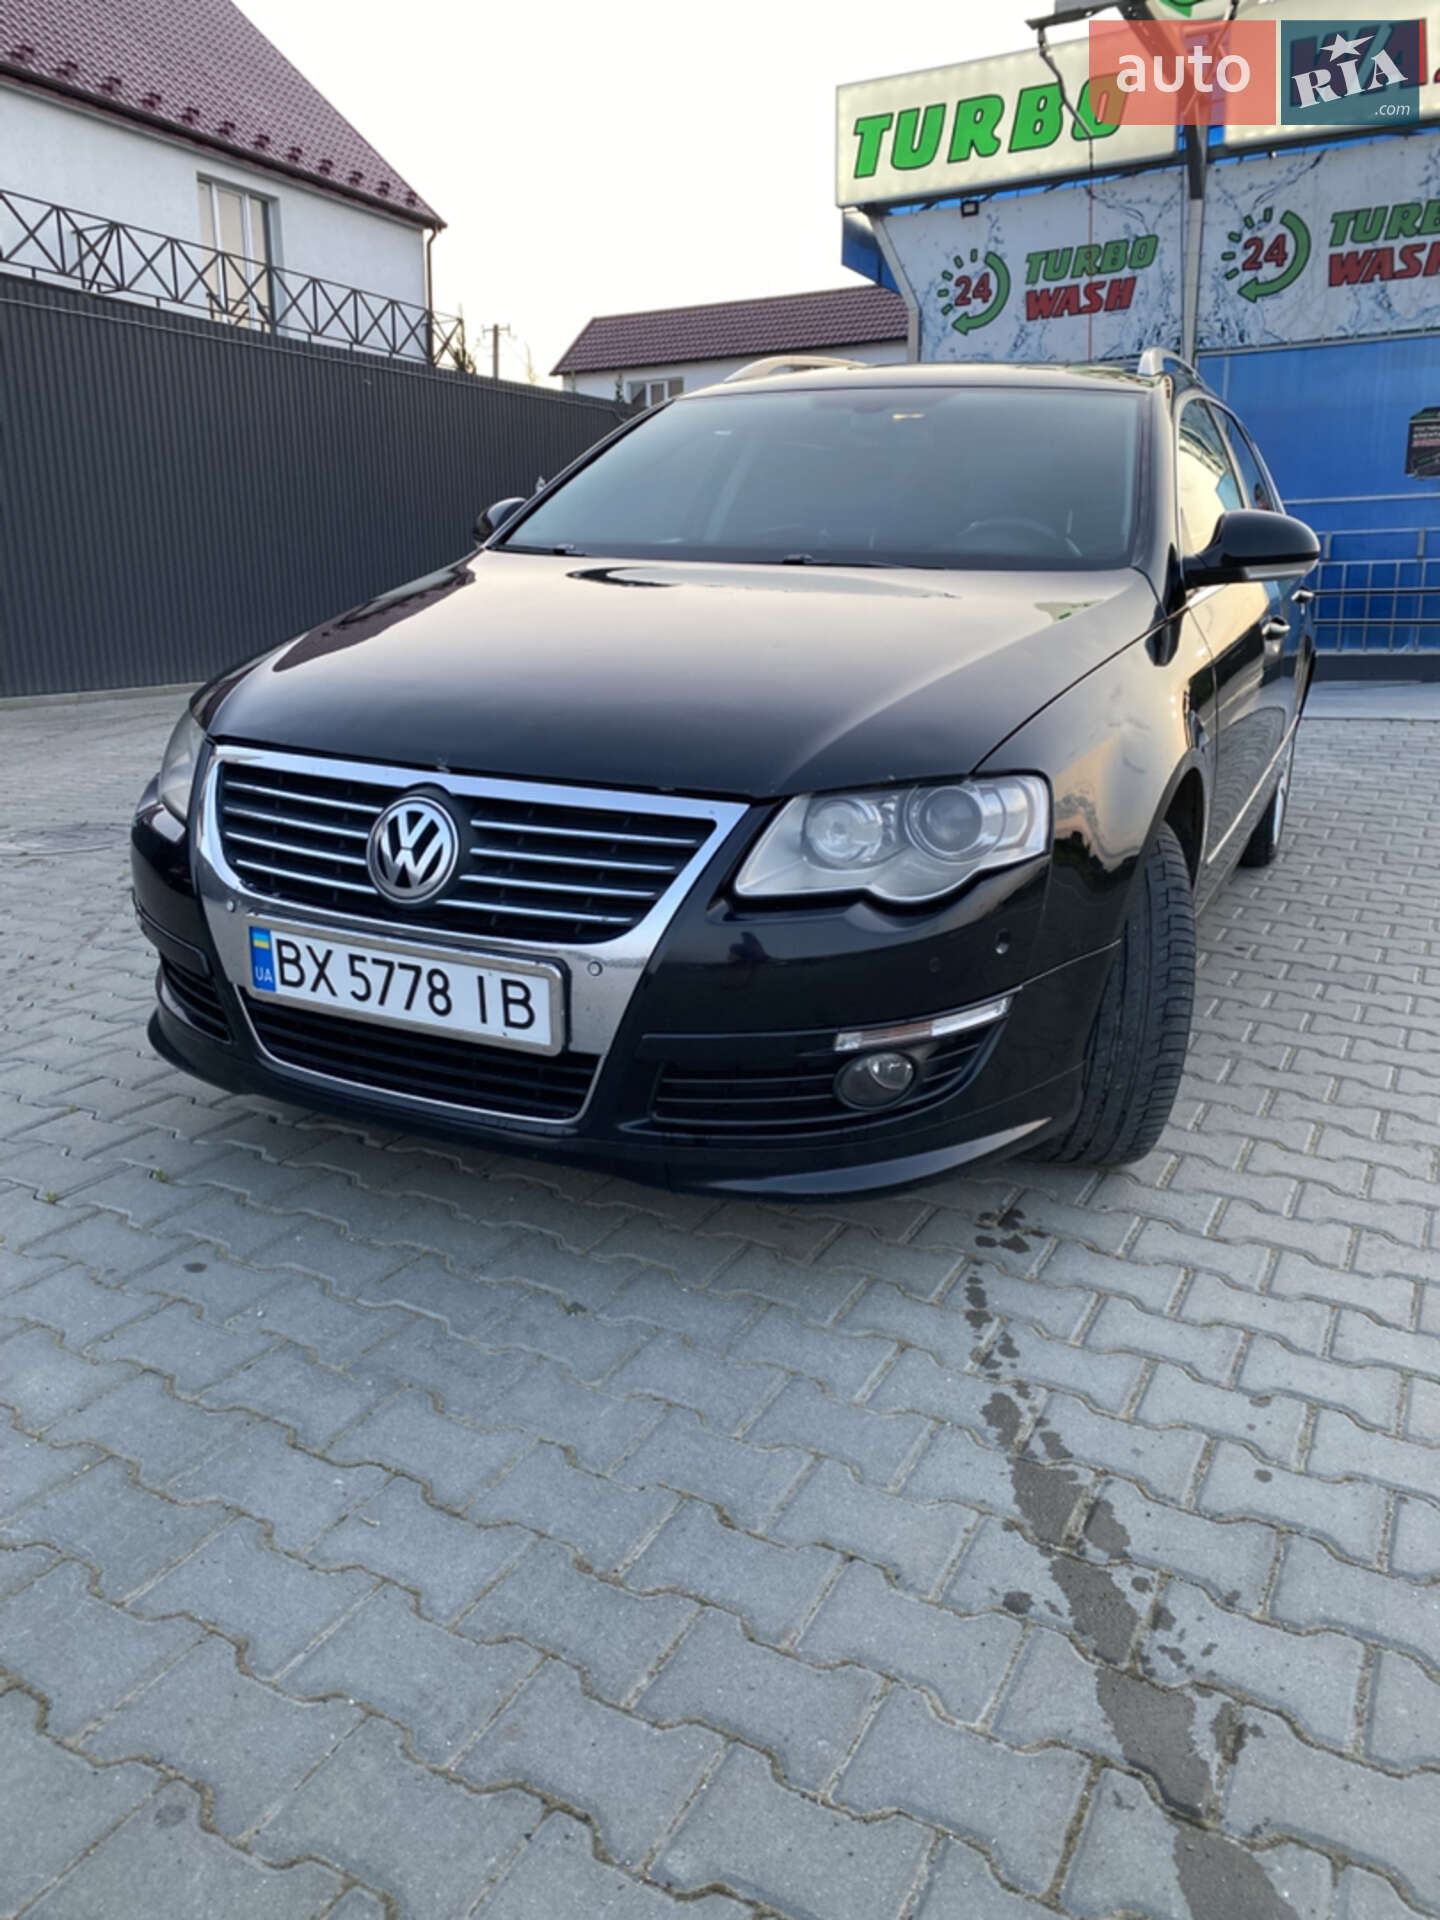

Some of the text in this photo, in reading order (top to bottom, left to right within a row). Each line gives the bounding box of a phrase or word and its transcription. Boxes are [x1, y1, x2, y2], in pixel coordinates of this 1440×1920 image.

[853, 72, 1131, 179] TURBO
[1025, 234, 1159, 285] TURBO
[1242, 233, 1288, 272] 24
[954, 272, 992, 307] 24
[1025, 276, 1137, 322] WASH
[255, 966, 273, 983] UA
[348, 953, 453, 1017] 5778
[476, 975, 536, 1030] IB
